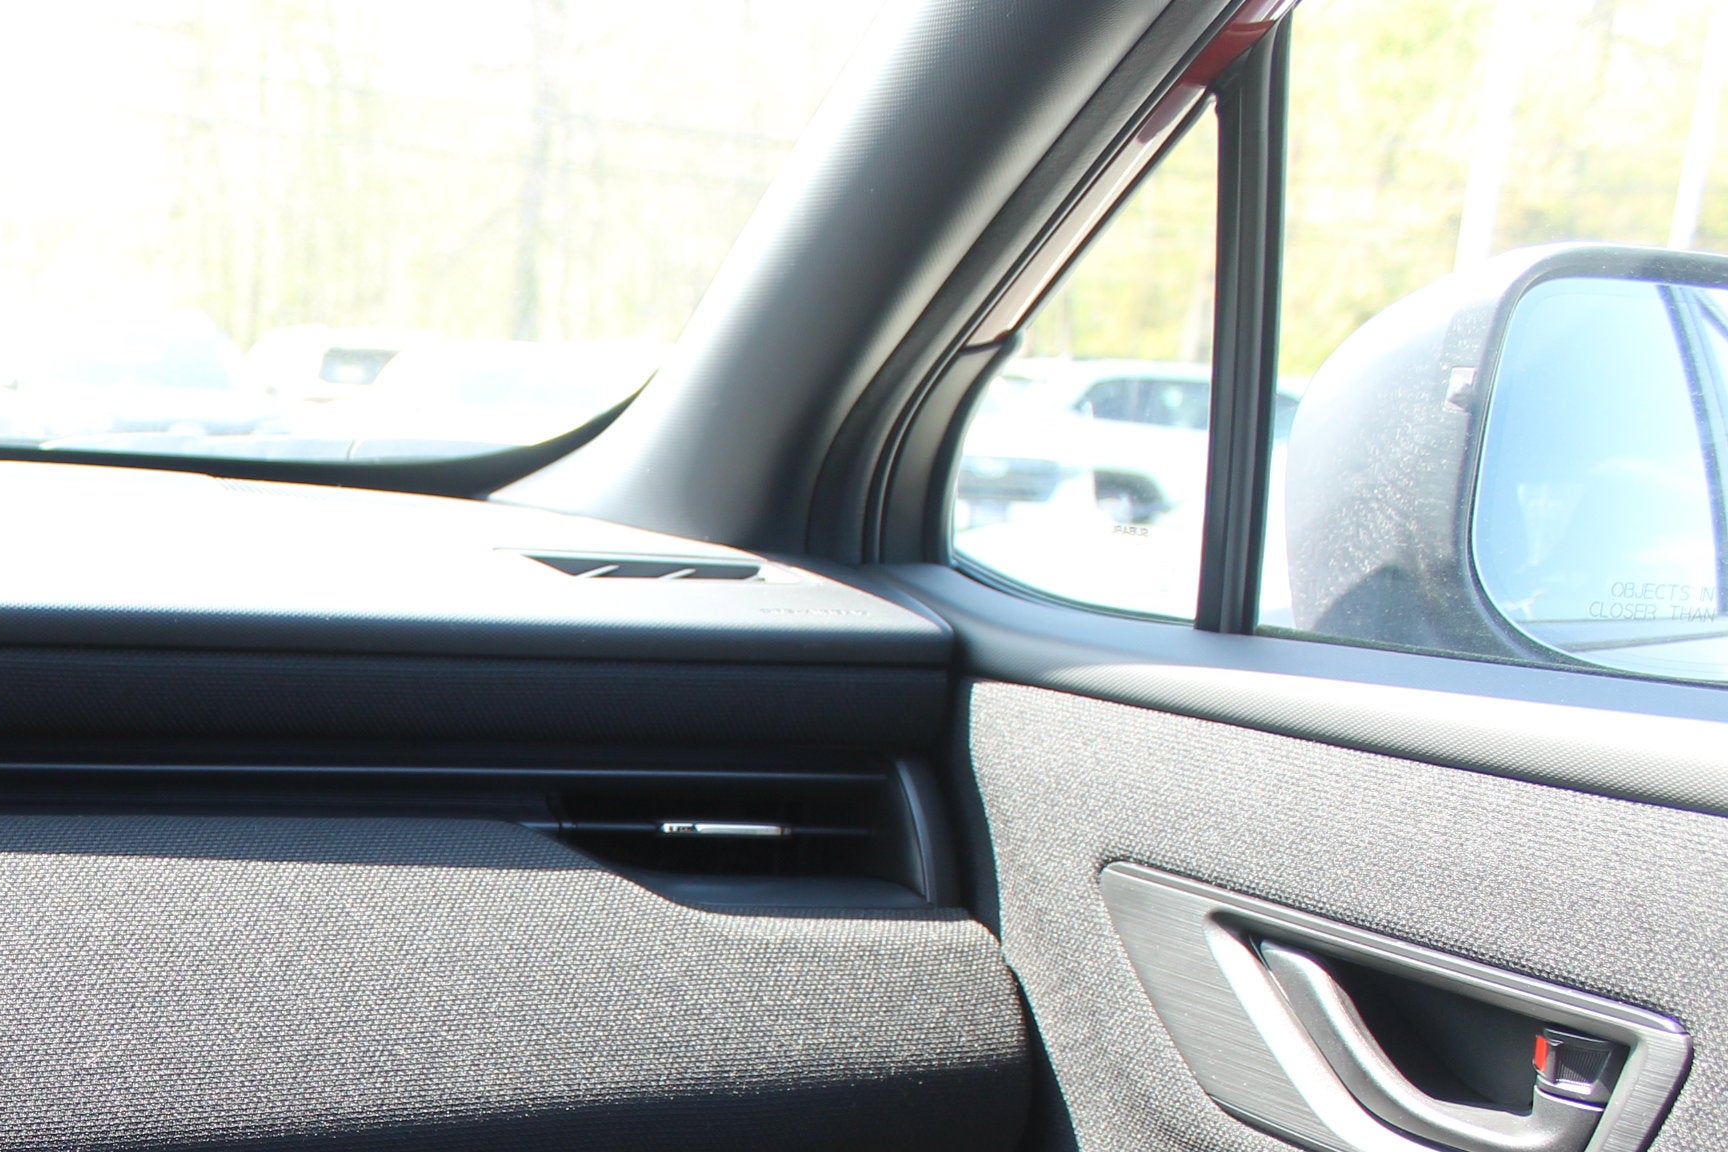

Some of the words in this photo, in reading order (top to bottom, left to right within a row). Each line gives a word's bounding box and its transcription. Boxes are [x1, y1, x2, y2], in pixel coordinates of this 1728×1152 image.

[1611, 582, 1690, 601] OBJECTS
[1700, 587, 1716, 601] IN
[1589, 601, 1656, 620] CLOSER
[1671, 605, 1716, 622] THAN
